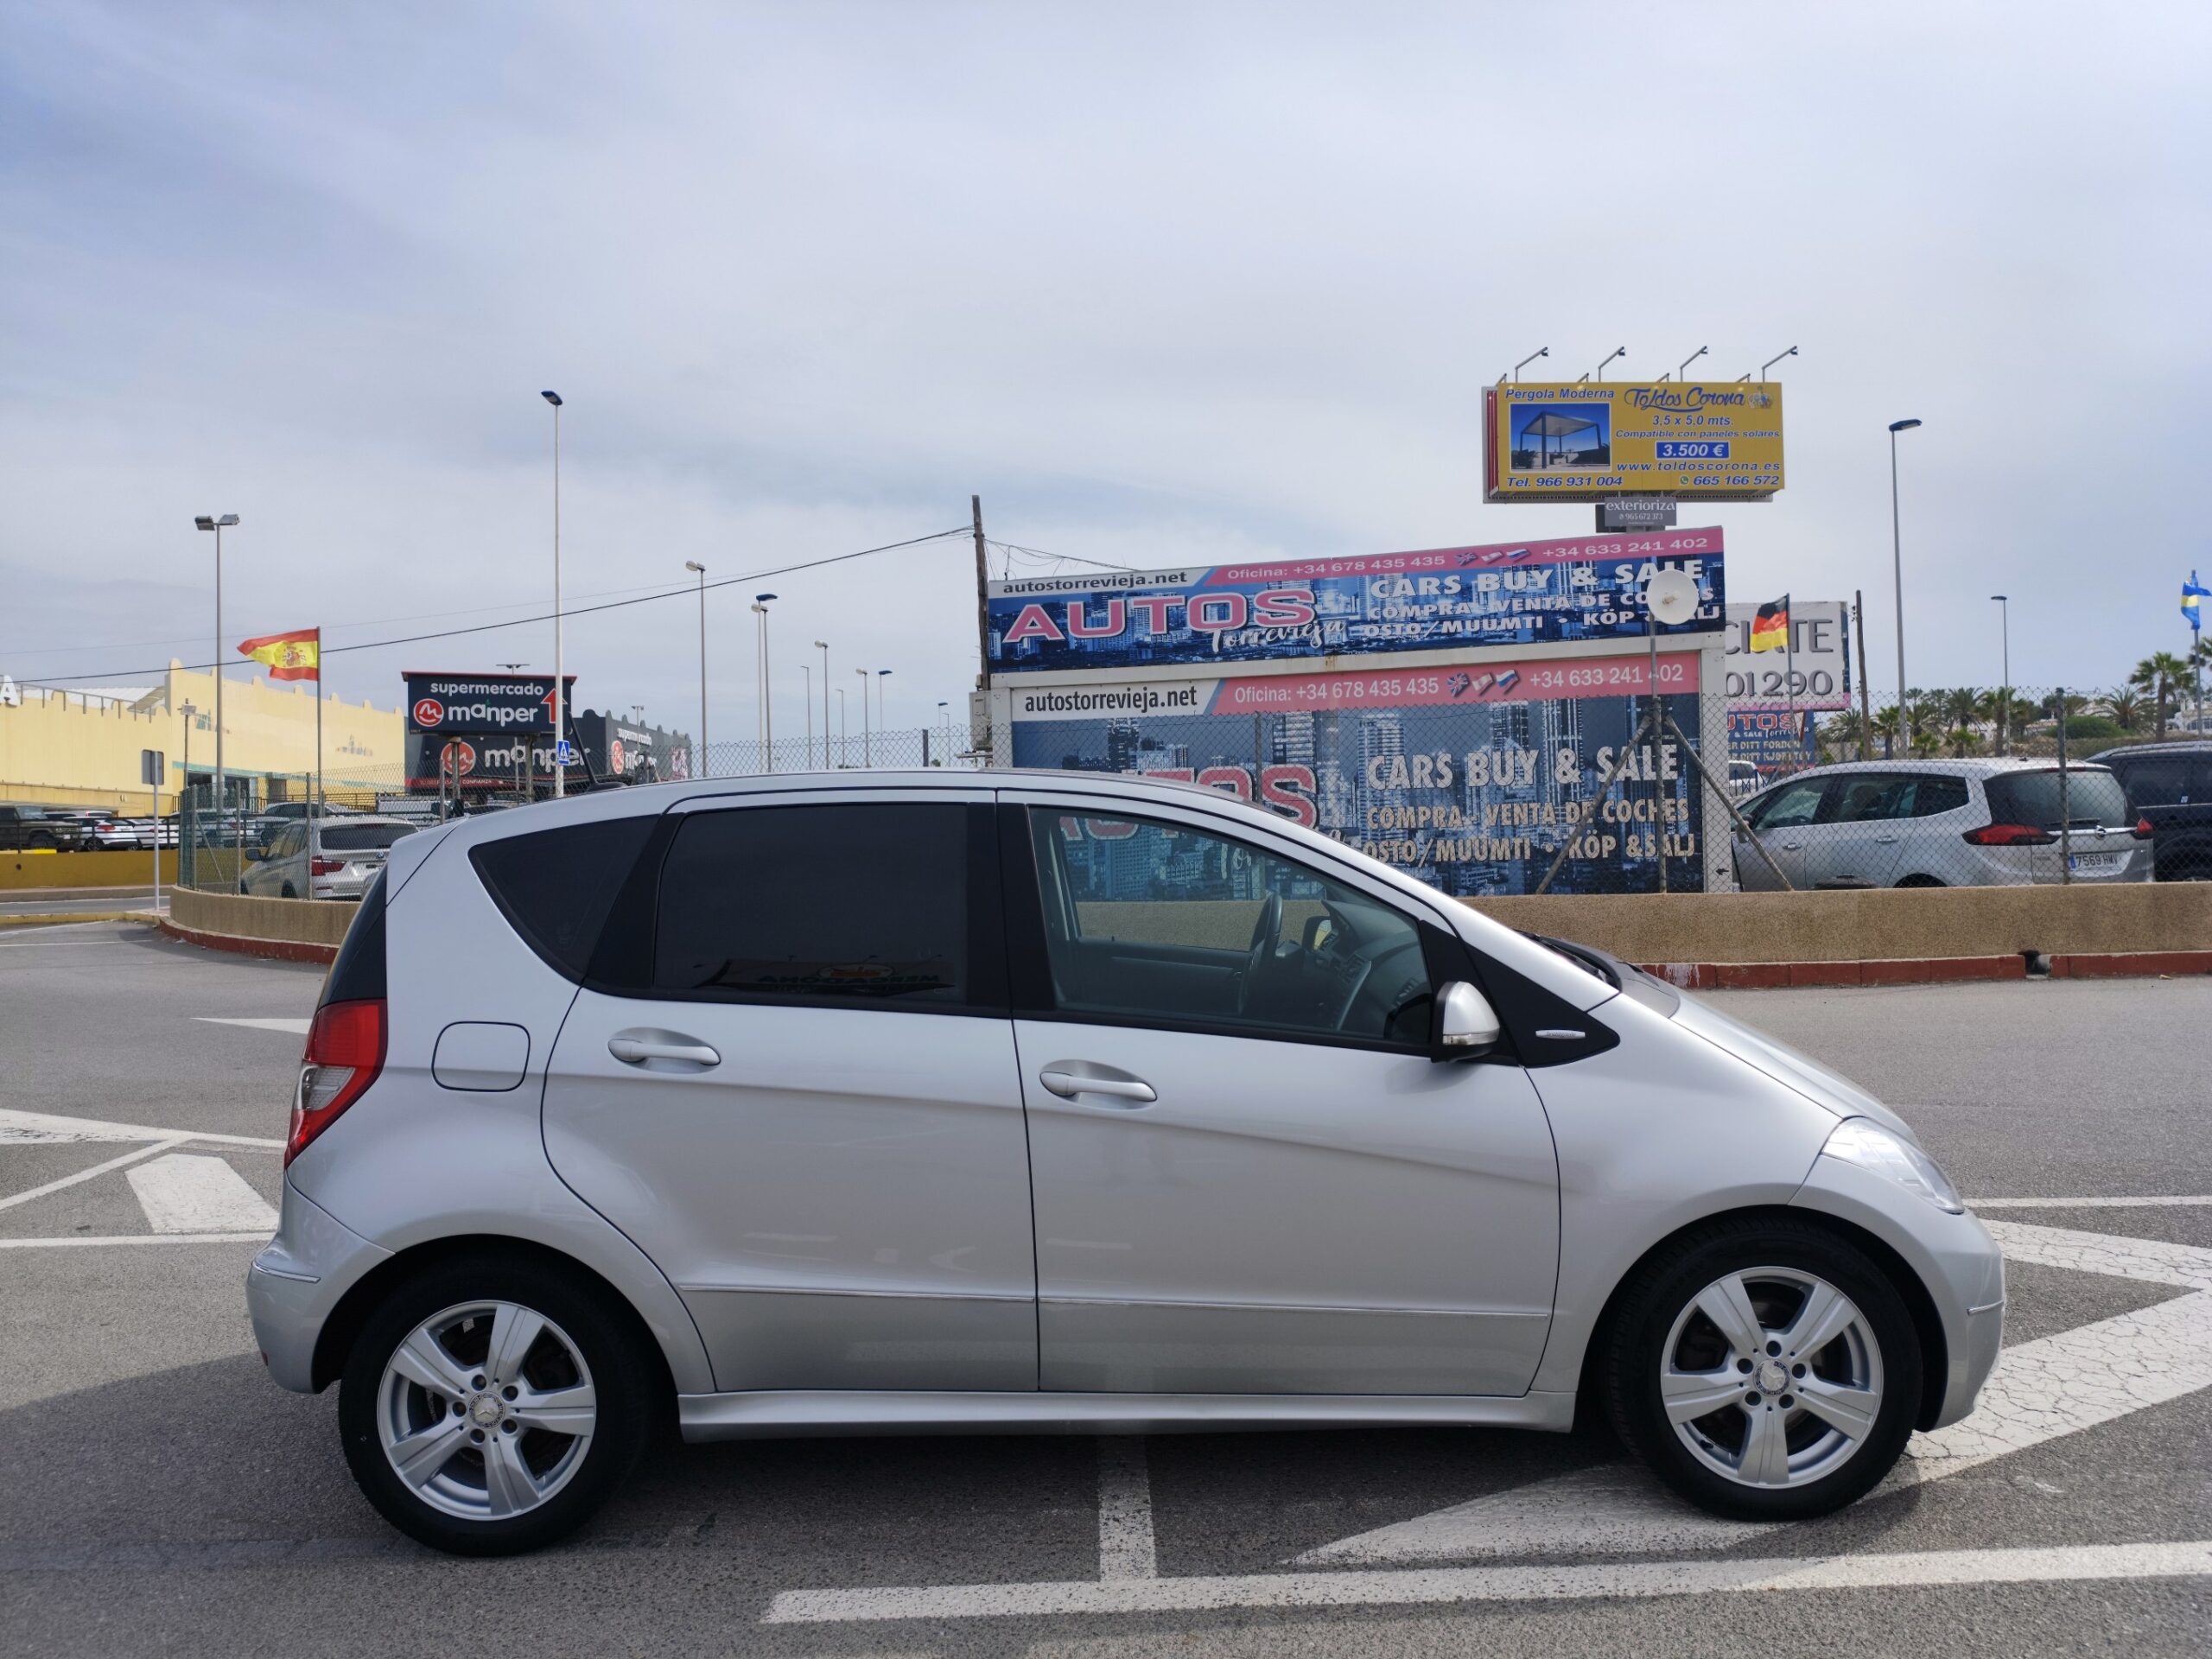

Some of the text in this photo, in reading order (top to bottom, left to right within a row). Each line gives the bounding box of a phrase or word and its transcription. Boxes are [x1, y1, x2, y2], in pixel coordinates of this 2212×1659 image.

[1560, 388, 1615, 399] Moderna
[1624, 386, 1745, 410] Toldos Corona
[1707, 416, 1734, 426] mts.
[1616, 429, 1675, 439] Compatible
[1699, 429, 1738, 439] paneles
[1742, 429, 1780, 438] solares
[1662, 443, 1725, 457] 3.500 €
[1617, 461, 1780, 471] www.toldoscorona.es
[1507, 476, 1623, 487] Tel. 966 931 004
[1694, 475, 1780, 486] 665 166 572
[1605, 499, 1676, 511] exterioriza
[1227, 537, 1708, 580] Oficina: +34 678 435 435 +34 633 241 402
[1003, 570, 1188, 594] autostorrevieja.net
[1370, 575, 1462, 599] CARS
[1478, 569, 1554, 592] BUY
[1570, 567, 1599, 587] &
[1001, 588, 1318, 644] AUTOS
[1369, 602, 1471, 620] COMPRA
[1496, 595, 1572, 613] VENTA
[1580, 594, 1611, 607] DE
[1583, 608, 1635, 626] KÖP
[1210, 619, 1346, 653] Torrevieja
[430, 682, 544, 697] supermercado
[1235, 686, 1292, 703] Oficina:
[1296, 683, 1328, 700] +34
[1332, 681, 1364, 698] 678
[1369, 679, 1402, 696] 435
[1406, 677, 1440, 695] 435
[1530, 671, 1564, 689] +34
[1569, 668, 1604, 687] 633
[1609, 665, 1643, 684] 241
[1025, 686, 1198, 713] autostorrevieja.net
[448, 702, 538, 728] manper
[1367, 744, 1678, 790] CARS BUY & SALE
[1367, 804, 1464, 830] COMPRA
[1485, 802, 1557, 826] VENTA
[1602, 798, 1689, 823] COCHES
[1568, 830, 1617, 859] KÖP
[2076, 854, 2101, 868] 7569
